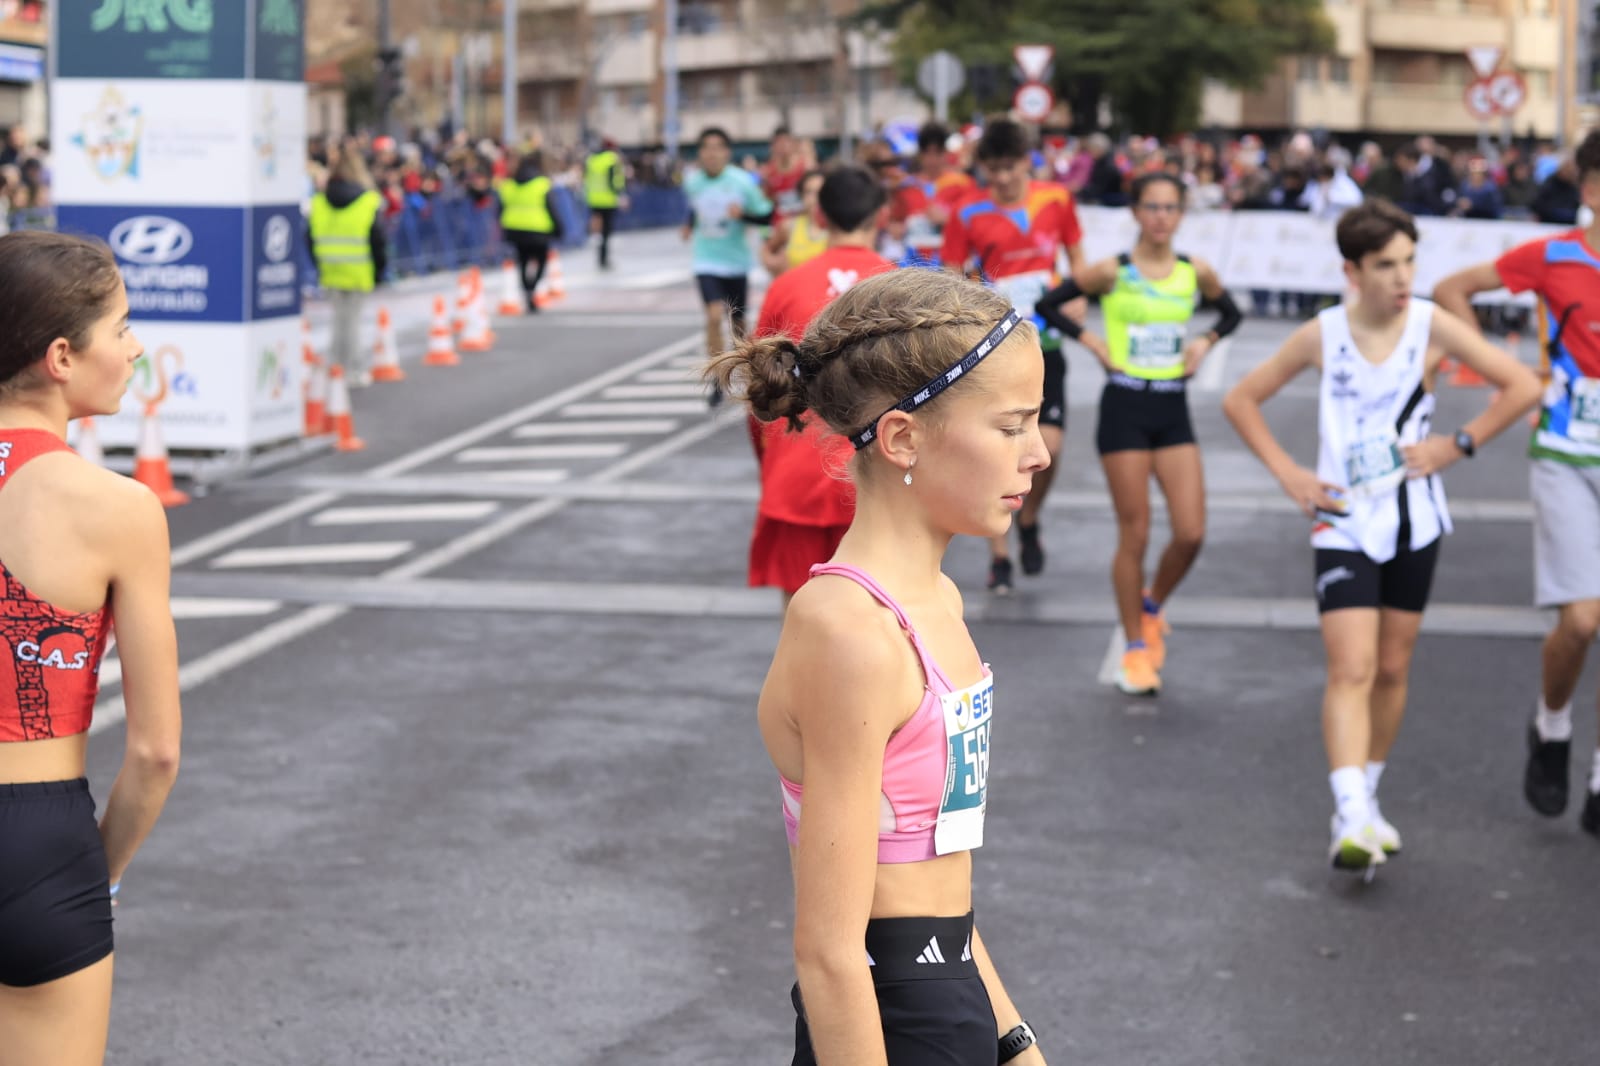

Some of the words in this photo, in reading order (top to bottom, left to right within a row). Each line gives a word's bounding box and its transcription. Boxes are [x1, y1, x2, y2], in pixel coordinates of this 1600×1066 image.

[913, 387, 931, 405] NIKE
[945, 363, 963, 384] NIKE
[976, 338, 992, 359] NIKE
[962, 720, 991, 796] 56
